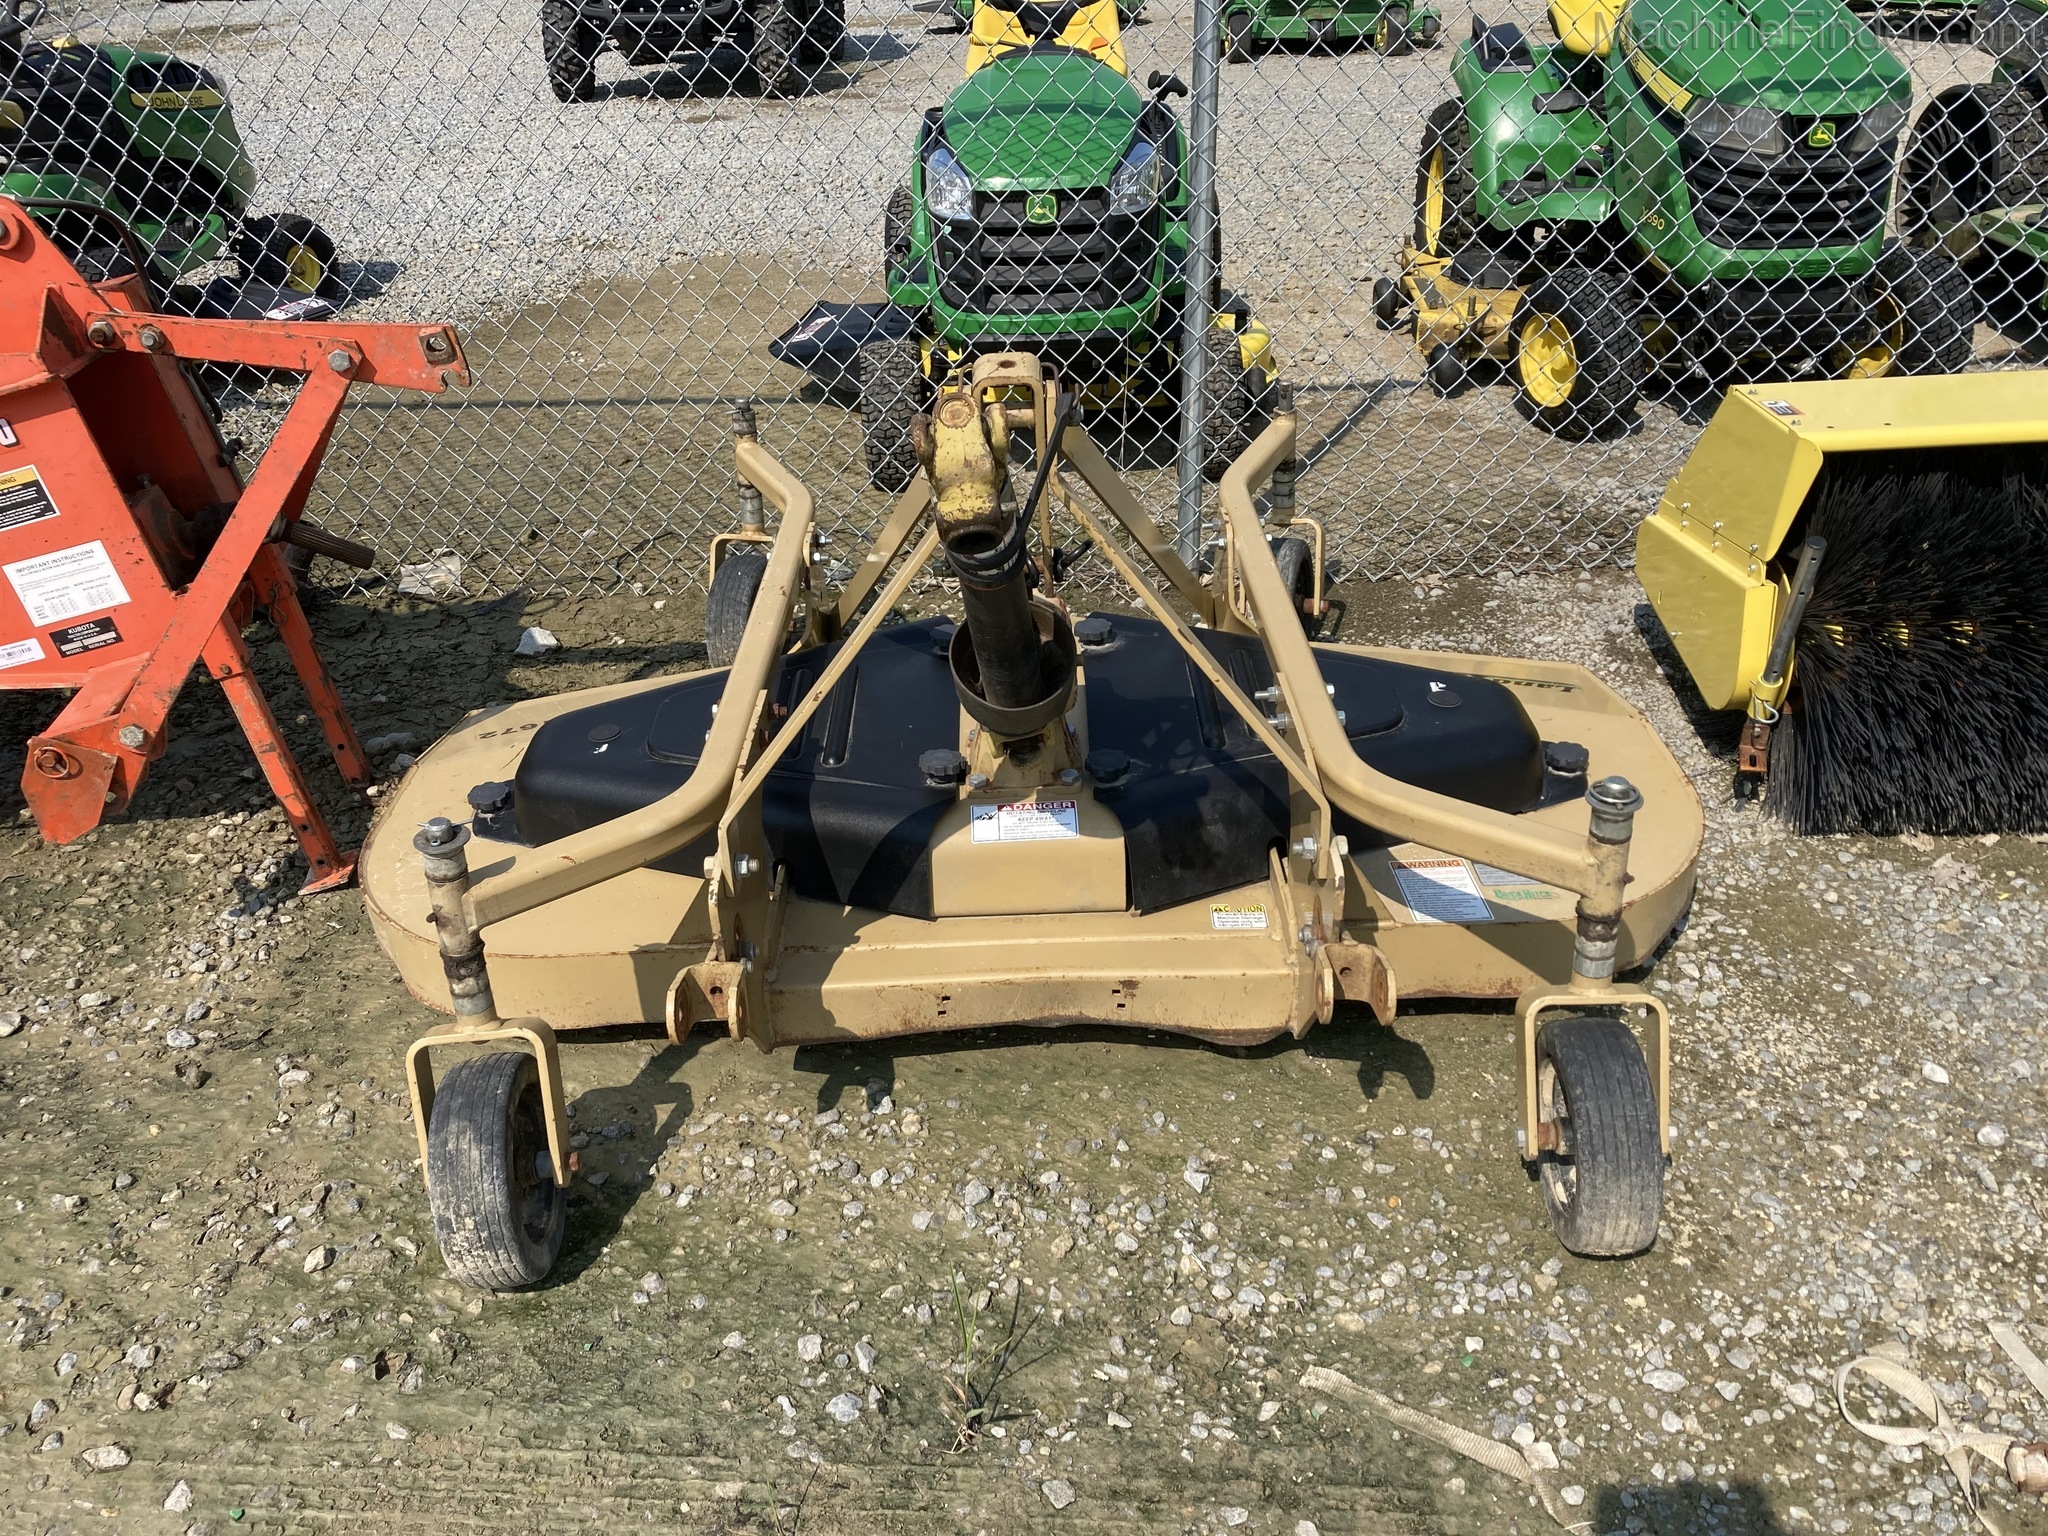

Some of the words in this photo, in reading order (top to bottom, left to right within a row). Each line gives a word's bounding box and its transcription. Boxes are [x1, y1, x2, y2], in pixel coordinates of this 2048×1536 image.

[150, 96, 176, 108] JOHN
[176, 95, 204, 107] DERE
[16, 561, 50, 573] IMPORTANT
[52, 549, 94, 563] INSTRUCTIONS
[68, 623, 95, 634] KUBOTA
[1013, 802, 1072, 811] DANGER
[1405, 860, 1462, 868] WARNING
